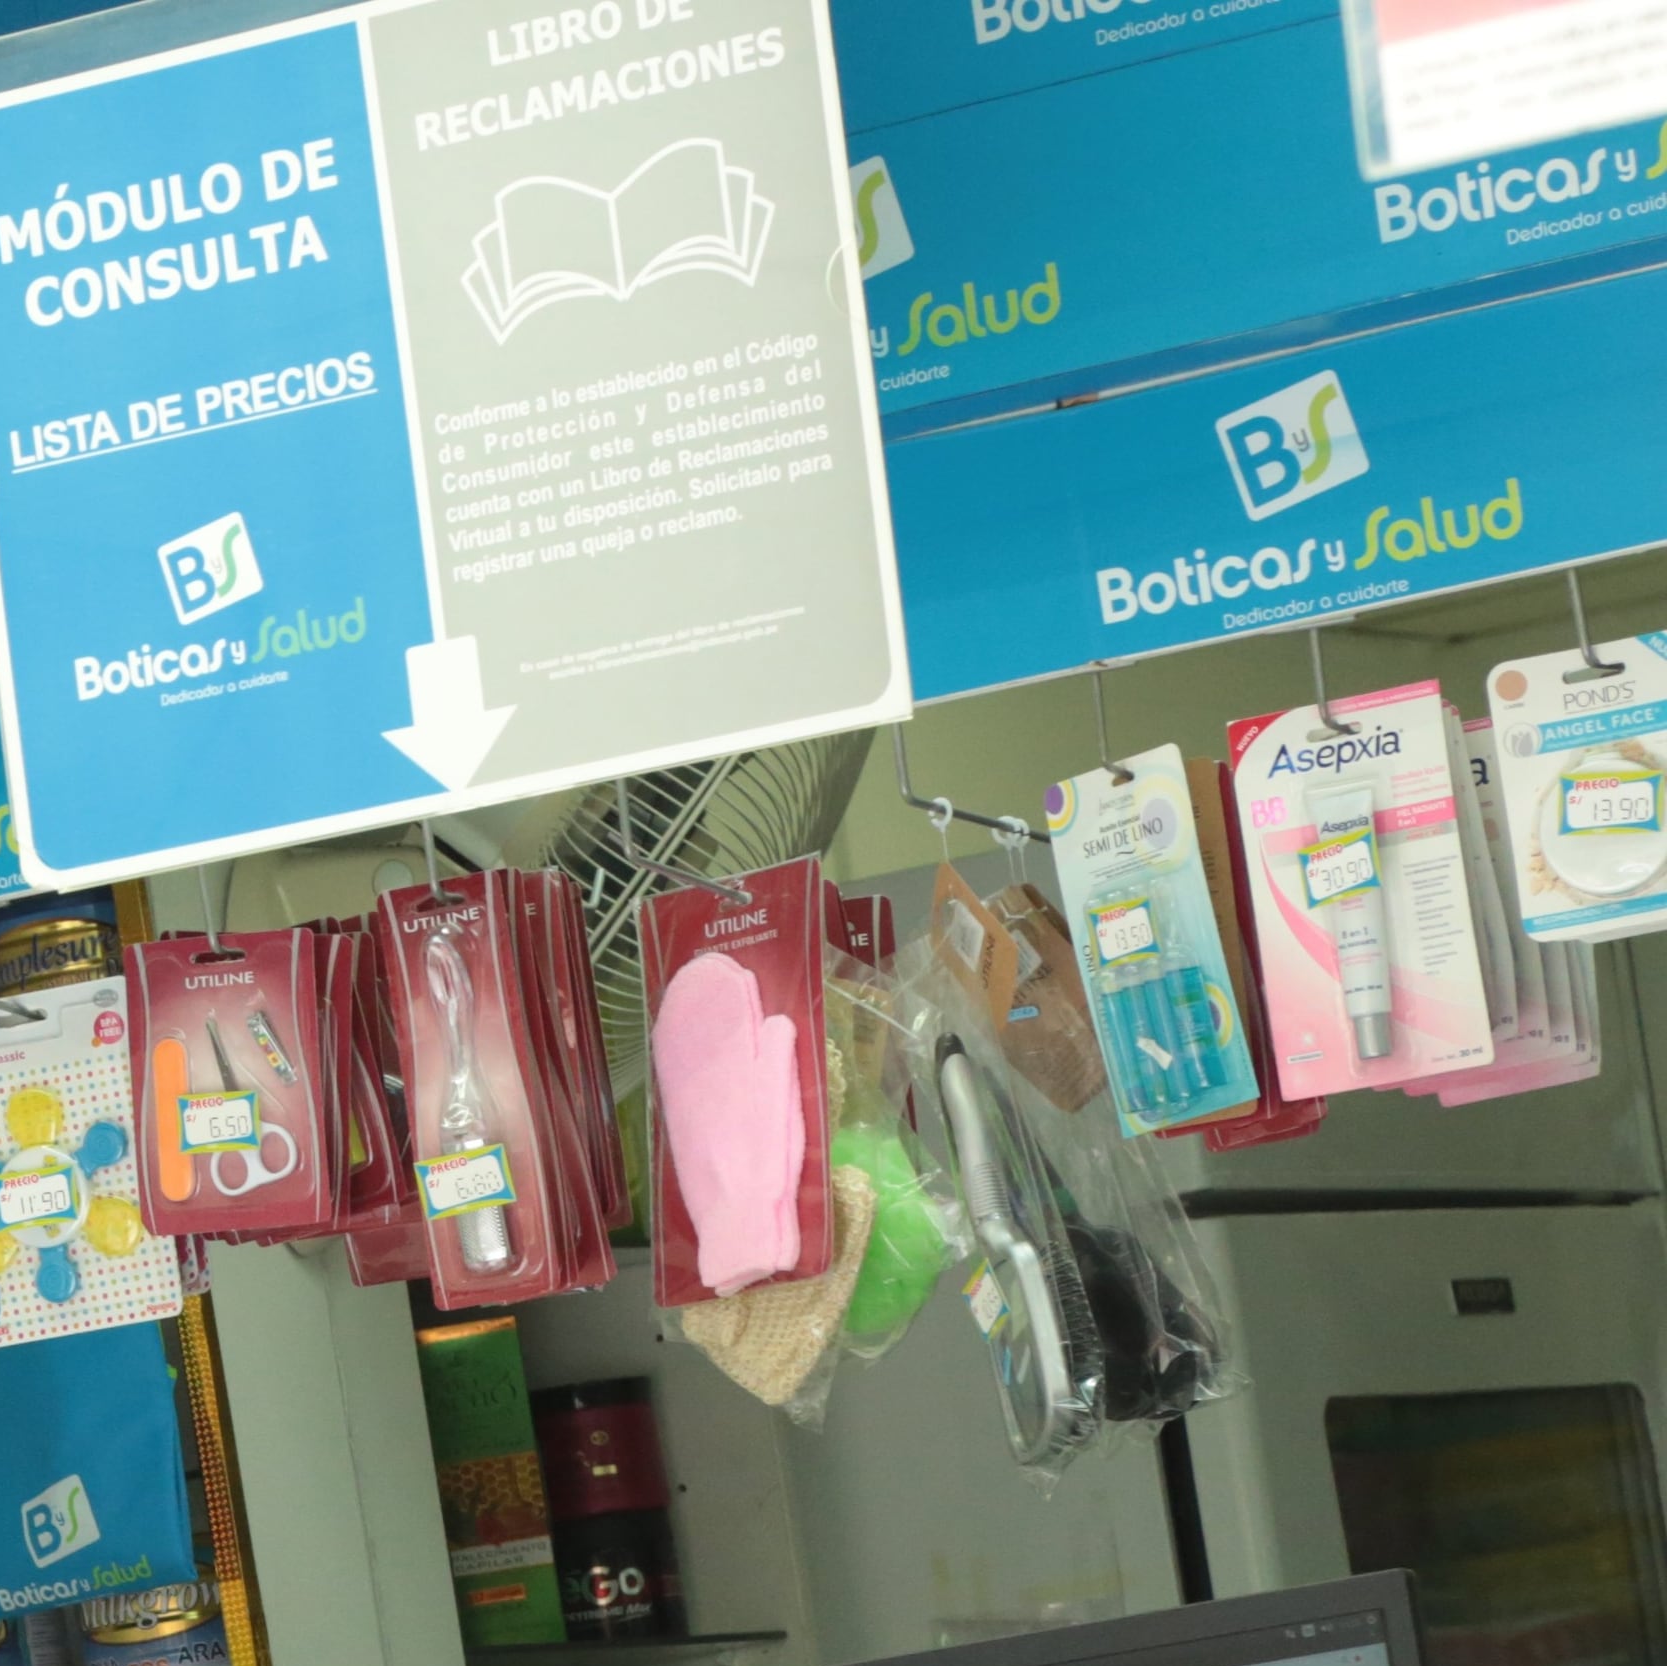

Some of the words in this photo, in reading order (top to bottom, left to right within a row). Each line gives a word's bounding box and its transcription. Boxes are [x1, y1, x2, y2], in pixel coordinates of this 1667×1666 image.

[487, 0, 623, 66] LIBRO
[638, 0, 695, 29] DE
[415, 26, 785, 151] RECLAMACIONES
[262, 138, 338, 202] DE
[25, 215, 329, 327] CONSULTA
[10, 412, 121, 466] LISTA
[128, 395, 186, 440] DE
[196, 352, 375, 425] PRECIOS
[434, 398, 530, 435] Conforme
[536, 396, 548, 412] a
[551, 387, 570, 408] lo
[576, 361, 687, 403] establecido
[693, 356, 717, 376] en
[723, 346, 740, 368] el
[746, 332, 818, 365] Código
[453, 546, 535, 584] registrar
[540, 542, 575, 563] una
[582, 530, 635, 559] queja
[640, 524, 652, 540] o
[659, 506, 743, 538] reclamo.
[1096, 539, 1316, 624] Boticas
[1325, 539, 1345, 571] y
[1353, 478, 1523, 571] Salud
[1267, 725, 1401, 779] Asepxia
[1544, 718, 1605, 741] ANGEL
[1611, 709, 1655, 726] FACE
[1083, 837, 1110, 858] SEMI
[1114, 831, 1129, 846] DE
[1132, 817, 1163, 842] LINO
[705, 909, 767, 938] UTILINE
[184, 970, 256, 989] UTILINE
[80, 1579, 90, 1591] y
[94, 1555, 152, 1590] Salud
